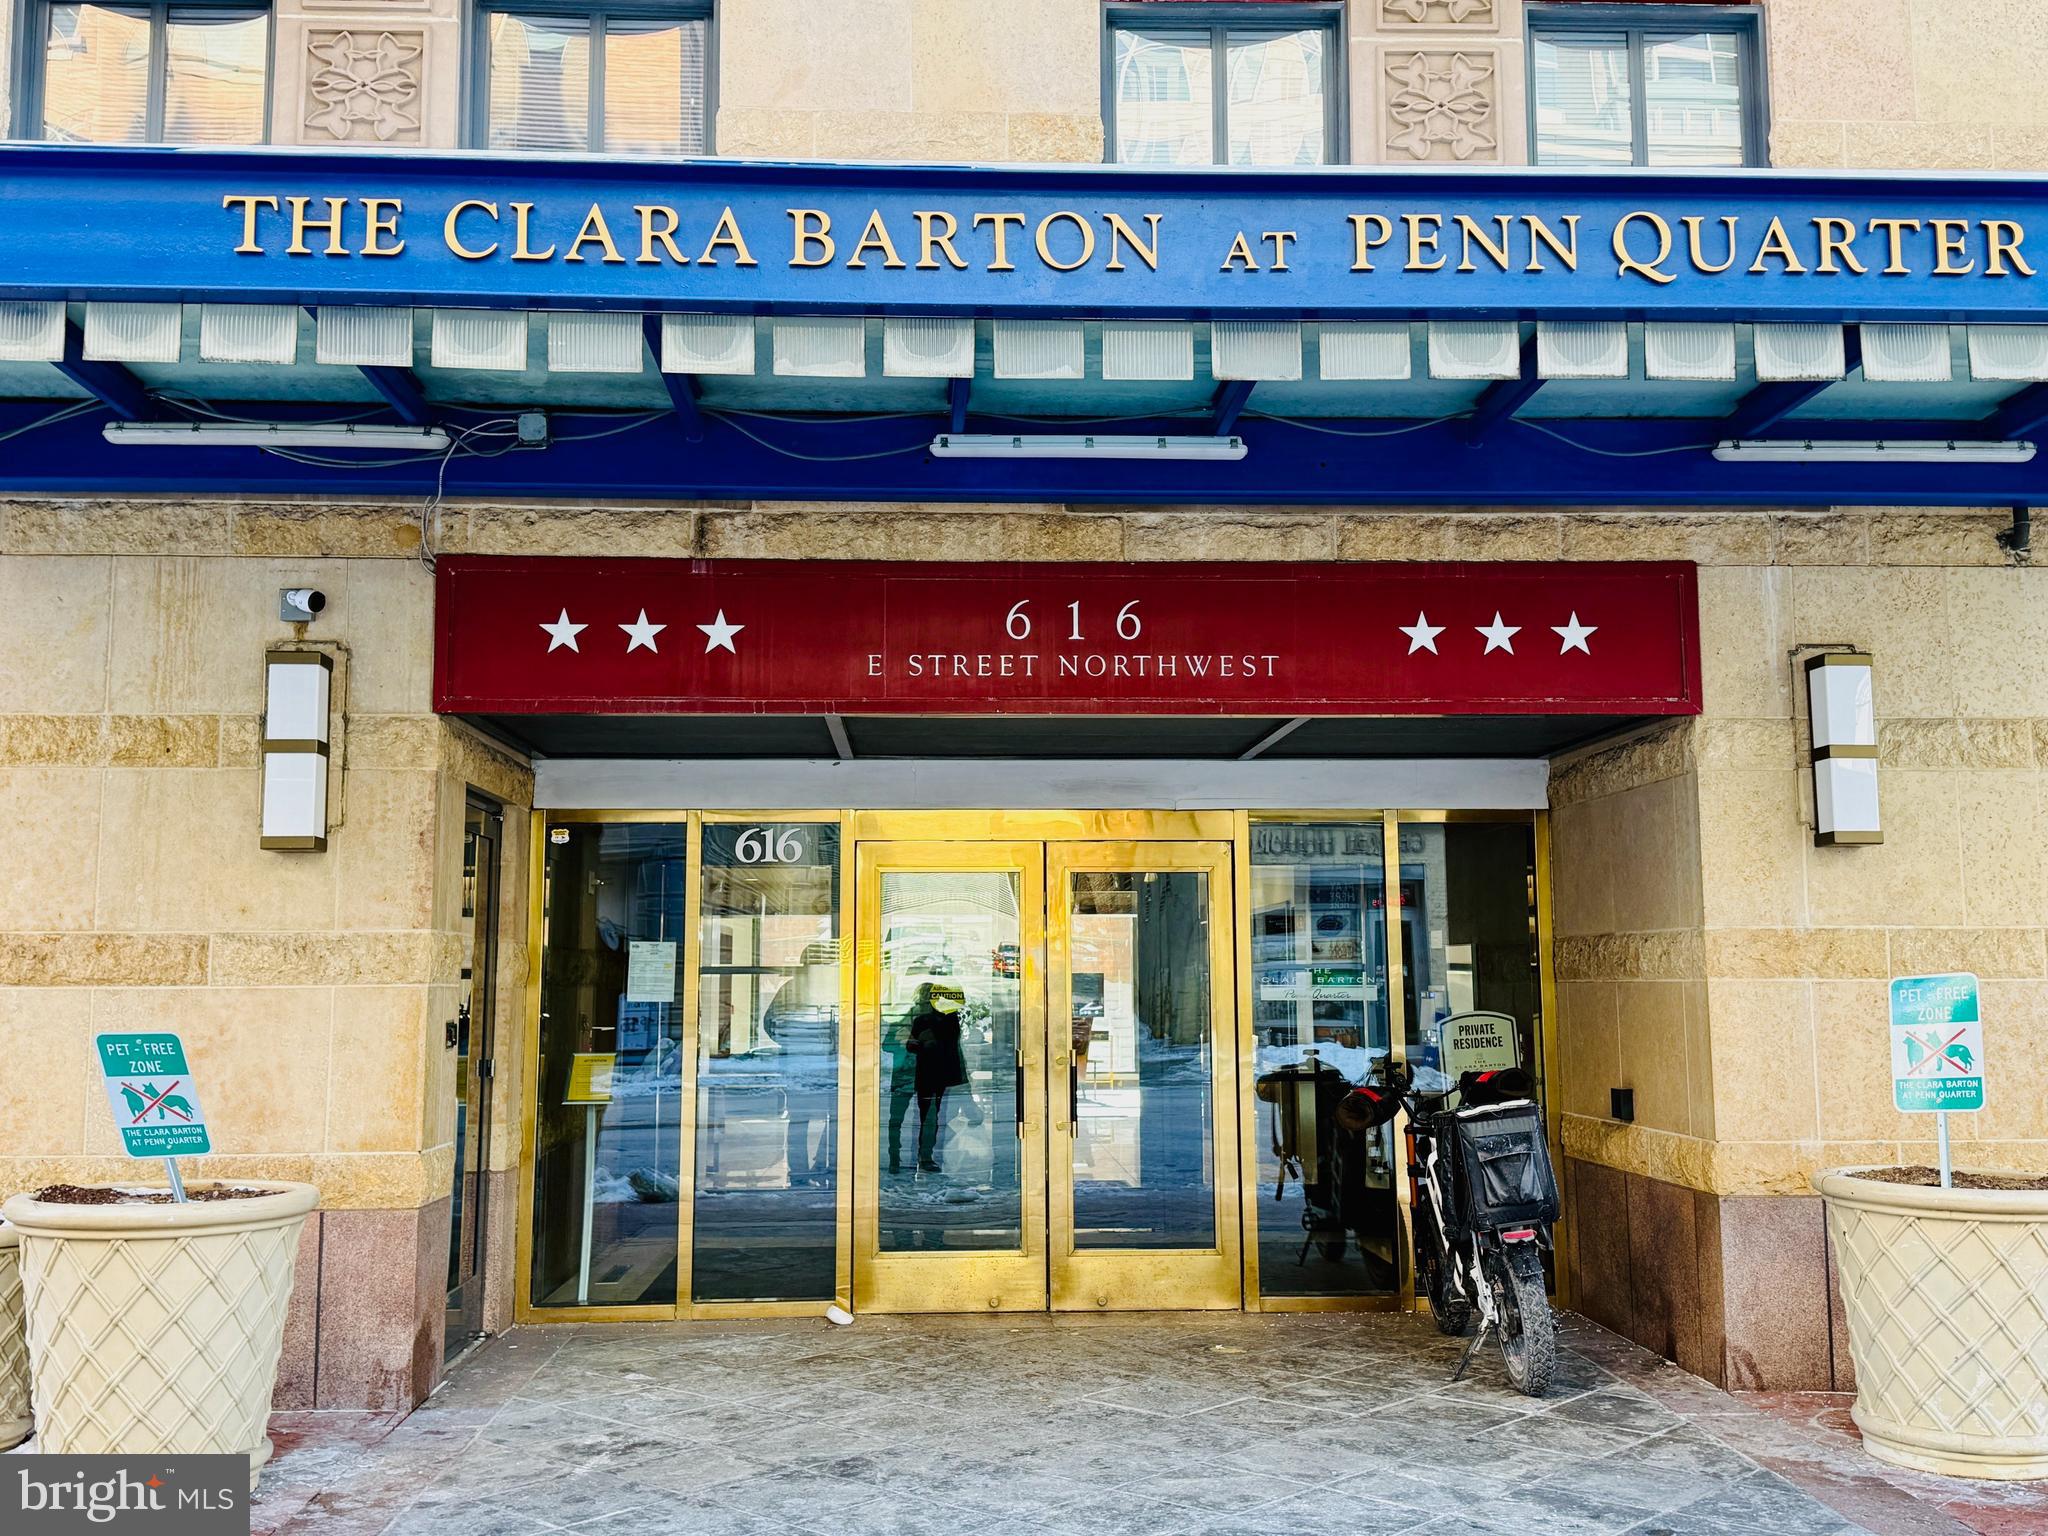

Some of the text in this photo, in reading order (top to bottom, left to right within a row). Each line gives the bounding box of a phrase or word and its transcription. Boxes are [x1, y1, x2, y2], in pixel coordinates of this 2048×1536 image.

[223, 195, 2036, 284] THE CLARA BARTON AT PENN QUARTER
[868, 654, 1280, 677] E STREET NORTHWEST
[735, 828, 802, 864] 616
[1317, 976, 1376, 984] BARTON
[1312, 988, 1352, 999] Quarter
[1899, 989, 1922, 1002] PET
[1936, 986, 1970, 1001] FREE
[1918, 1006, 1953, 1021] ZONE
[1458, 1024, 1496, 1036] PRIVATE
[106, 1044, 130, 1056] PET
[144, 1043, 176, 1055] FREE
[1453, 1036, 1504, 1050] RESIDENCE
[129, 1060, 164, 1073] ZONE
[1918, 1080, 1944, 1088] CLARA
[1946, 1080, 1978, 1088] BARTON
[1902, 1090, 1977, 1100] AT PENN QUARTER
[126, 1126, 202, 1137] THE CLARA BARTON
[132, 1136, 203, 1147] AT PENN QUARTER
